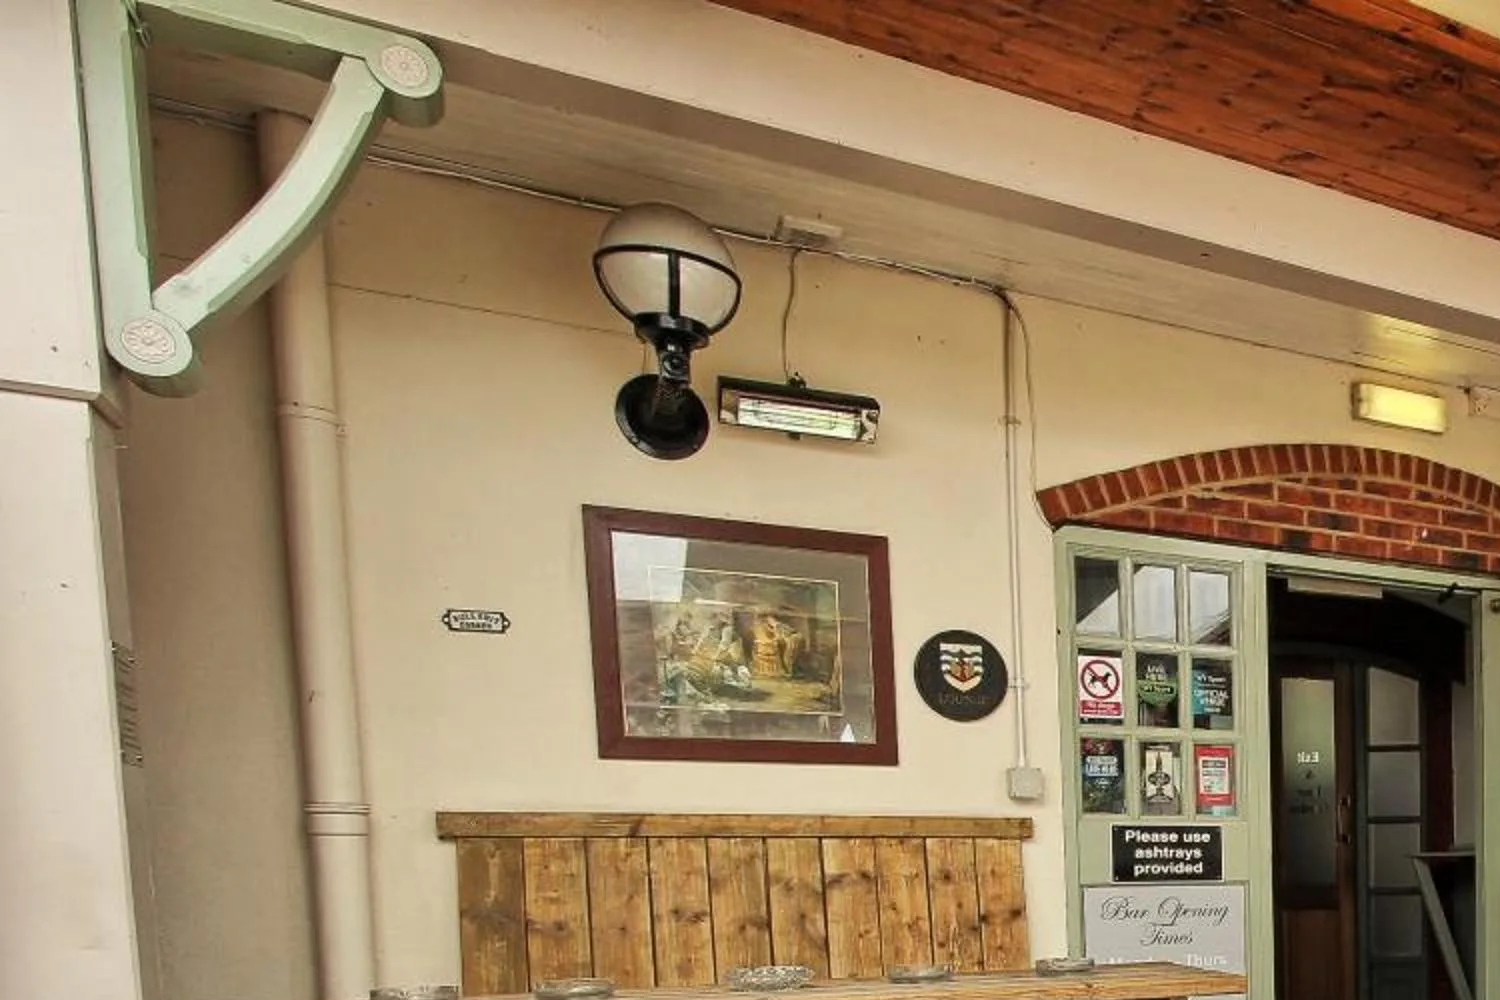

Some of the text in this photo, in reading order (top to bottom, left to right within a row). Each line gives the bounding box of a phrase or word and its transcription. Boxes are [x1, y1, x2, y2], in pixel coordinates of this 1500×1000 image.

[1125, 830, 1211, 843] Please use
[1135, 846, 1202, 861] ashtrays
[1134, 861, 1203, 877] provided
[1101, 896, 1230, 927] Bar Opening
[1140, 925, 1194, 947] Times
